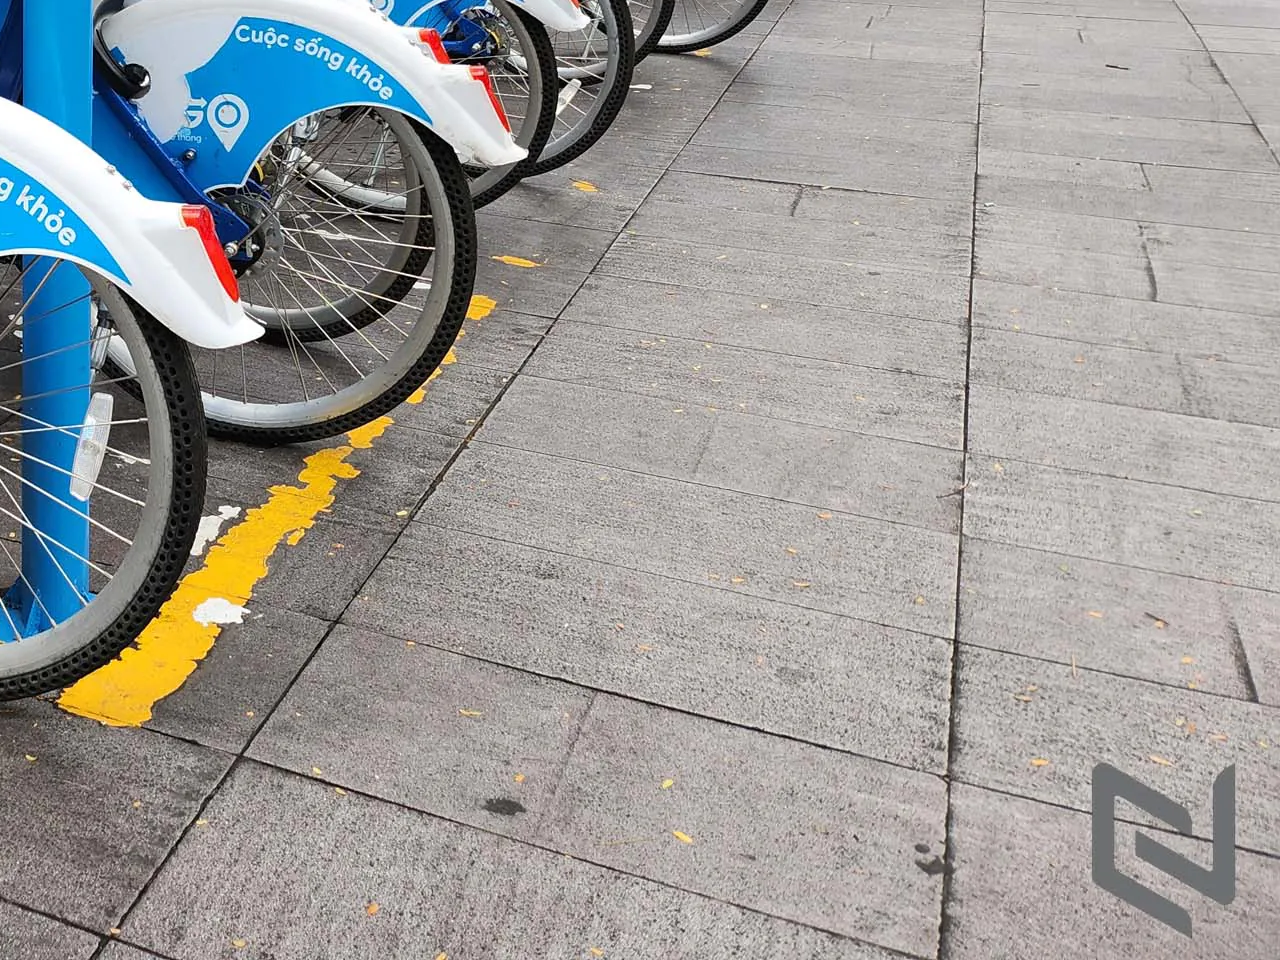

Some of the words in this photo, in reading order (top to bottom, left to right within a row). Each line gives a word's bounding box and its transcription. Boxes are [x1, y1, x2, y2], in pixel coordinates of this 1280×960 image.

[235, 24, 289, 48] Cuộc
[294, 37, 344, 71] sống
[346, 58, 393, 100] khỏe
[15, 185, 77, 246] khỏe
